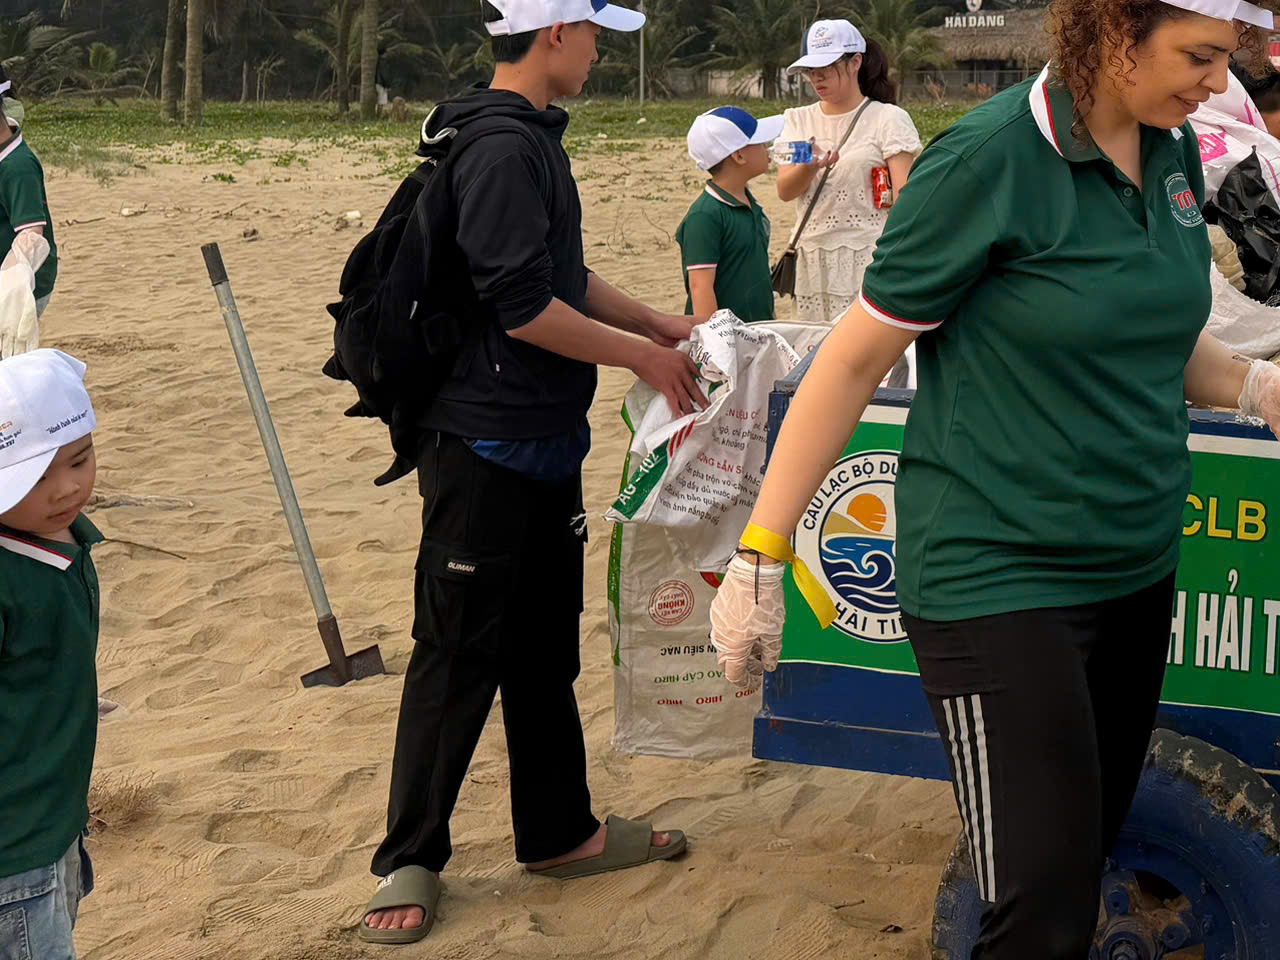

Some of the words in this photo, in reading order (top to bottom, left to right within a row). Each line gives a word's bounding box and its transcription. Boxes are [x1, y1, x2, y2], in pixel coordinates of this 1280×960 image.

[820, 470, 849, 498] LẠC
[851, 458, 875, 479] BỘ
[1182, 494, 1267, 541] CLB
[1195, 568, 1253, 672] HẢI
